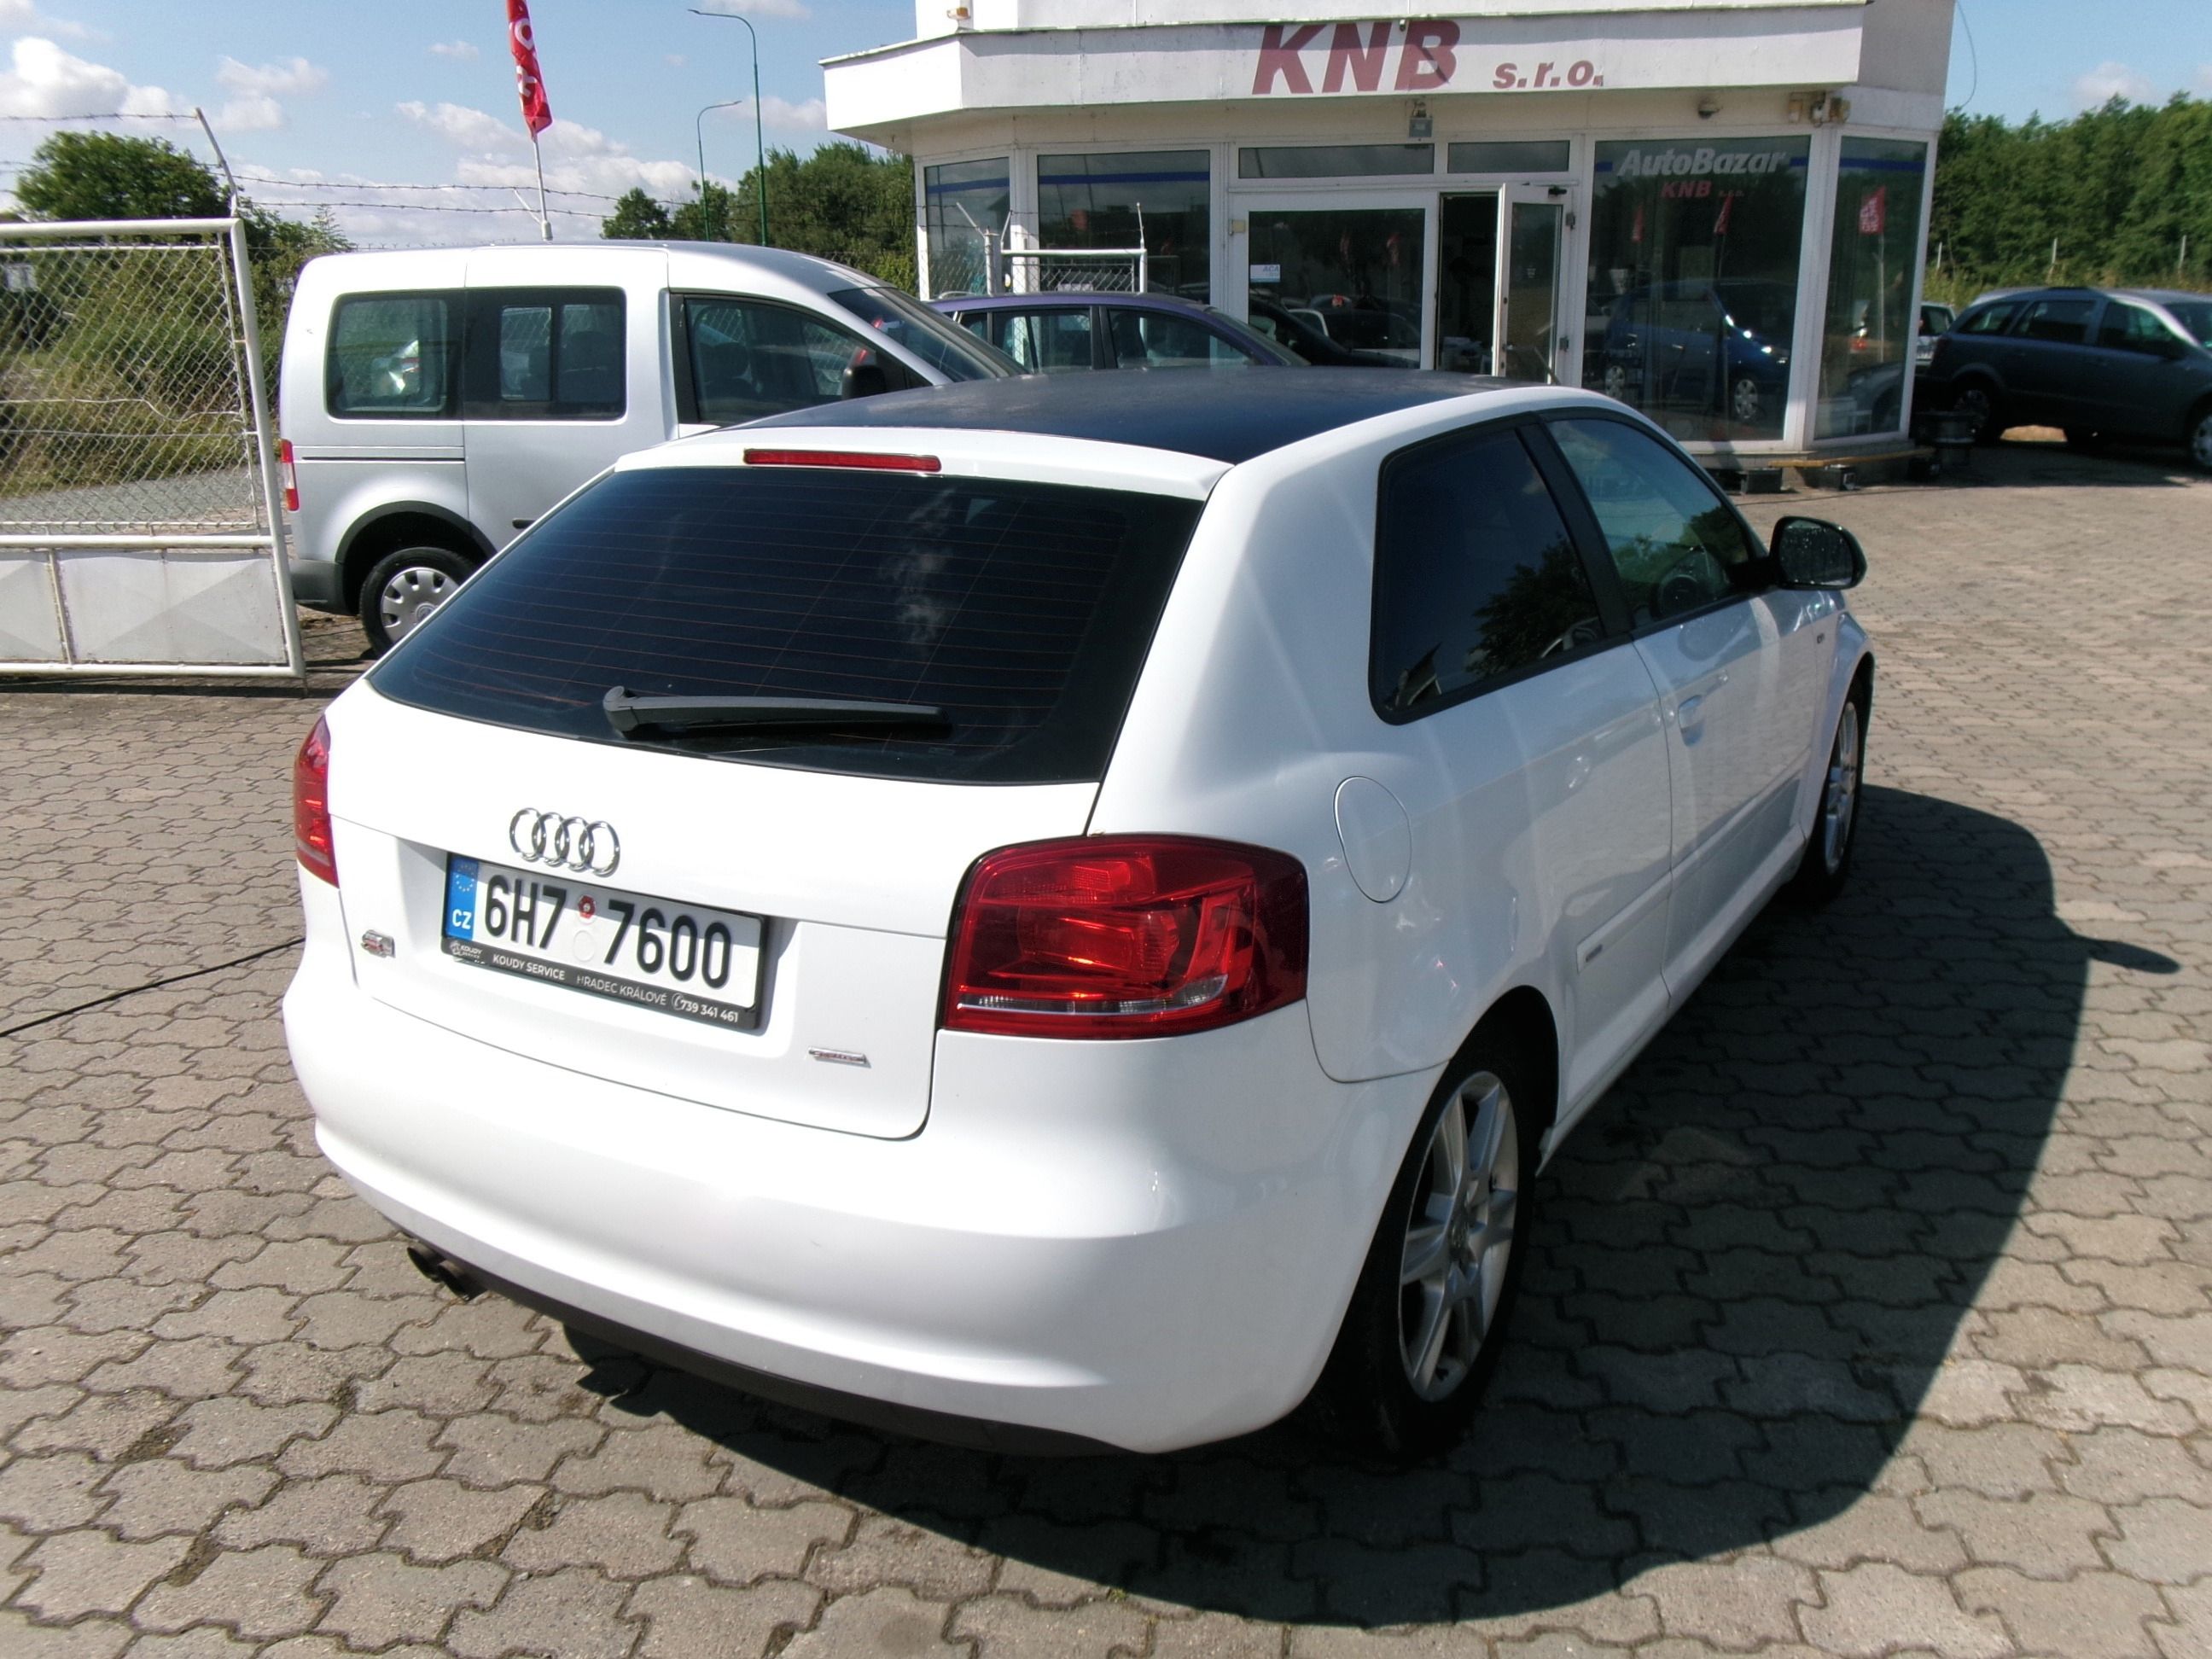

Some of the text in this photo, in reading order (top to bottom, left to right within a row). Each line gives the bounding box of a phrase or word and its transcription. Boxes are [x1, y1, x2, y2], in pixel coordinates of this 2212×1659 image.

[1252, 19, 1604, 95] KNB s.r.o.
[1617, 148, 1787, 177] AutoBazar
[1661, 180, 1712, 198] KNB
[451, 908, 472, 929] CZ
[485, 874, 732, 989] 6H7 7600
[492, 953, 526, 969] KOUDY
[526, 962, 566, 981] SERVICE
[576, 975, 618, 993] HRADEC
[620, 985, 667, 1005] KRÁLOVÉ
[700, 1004, 719, 1018] 341
[720, 1009, 739, 1023] 461
